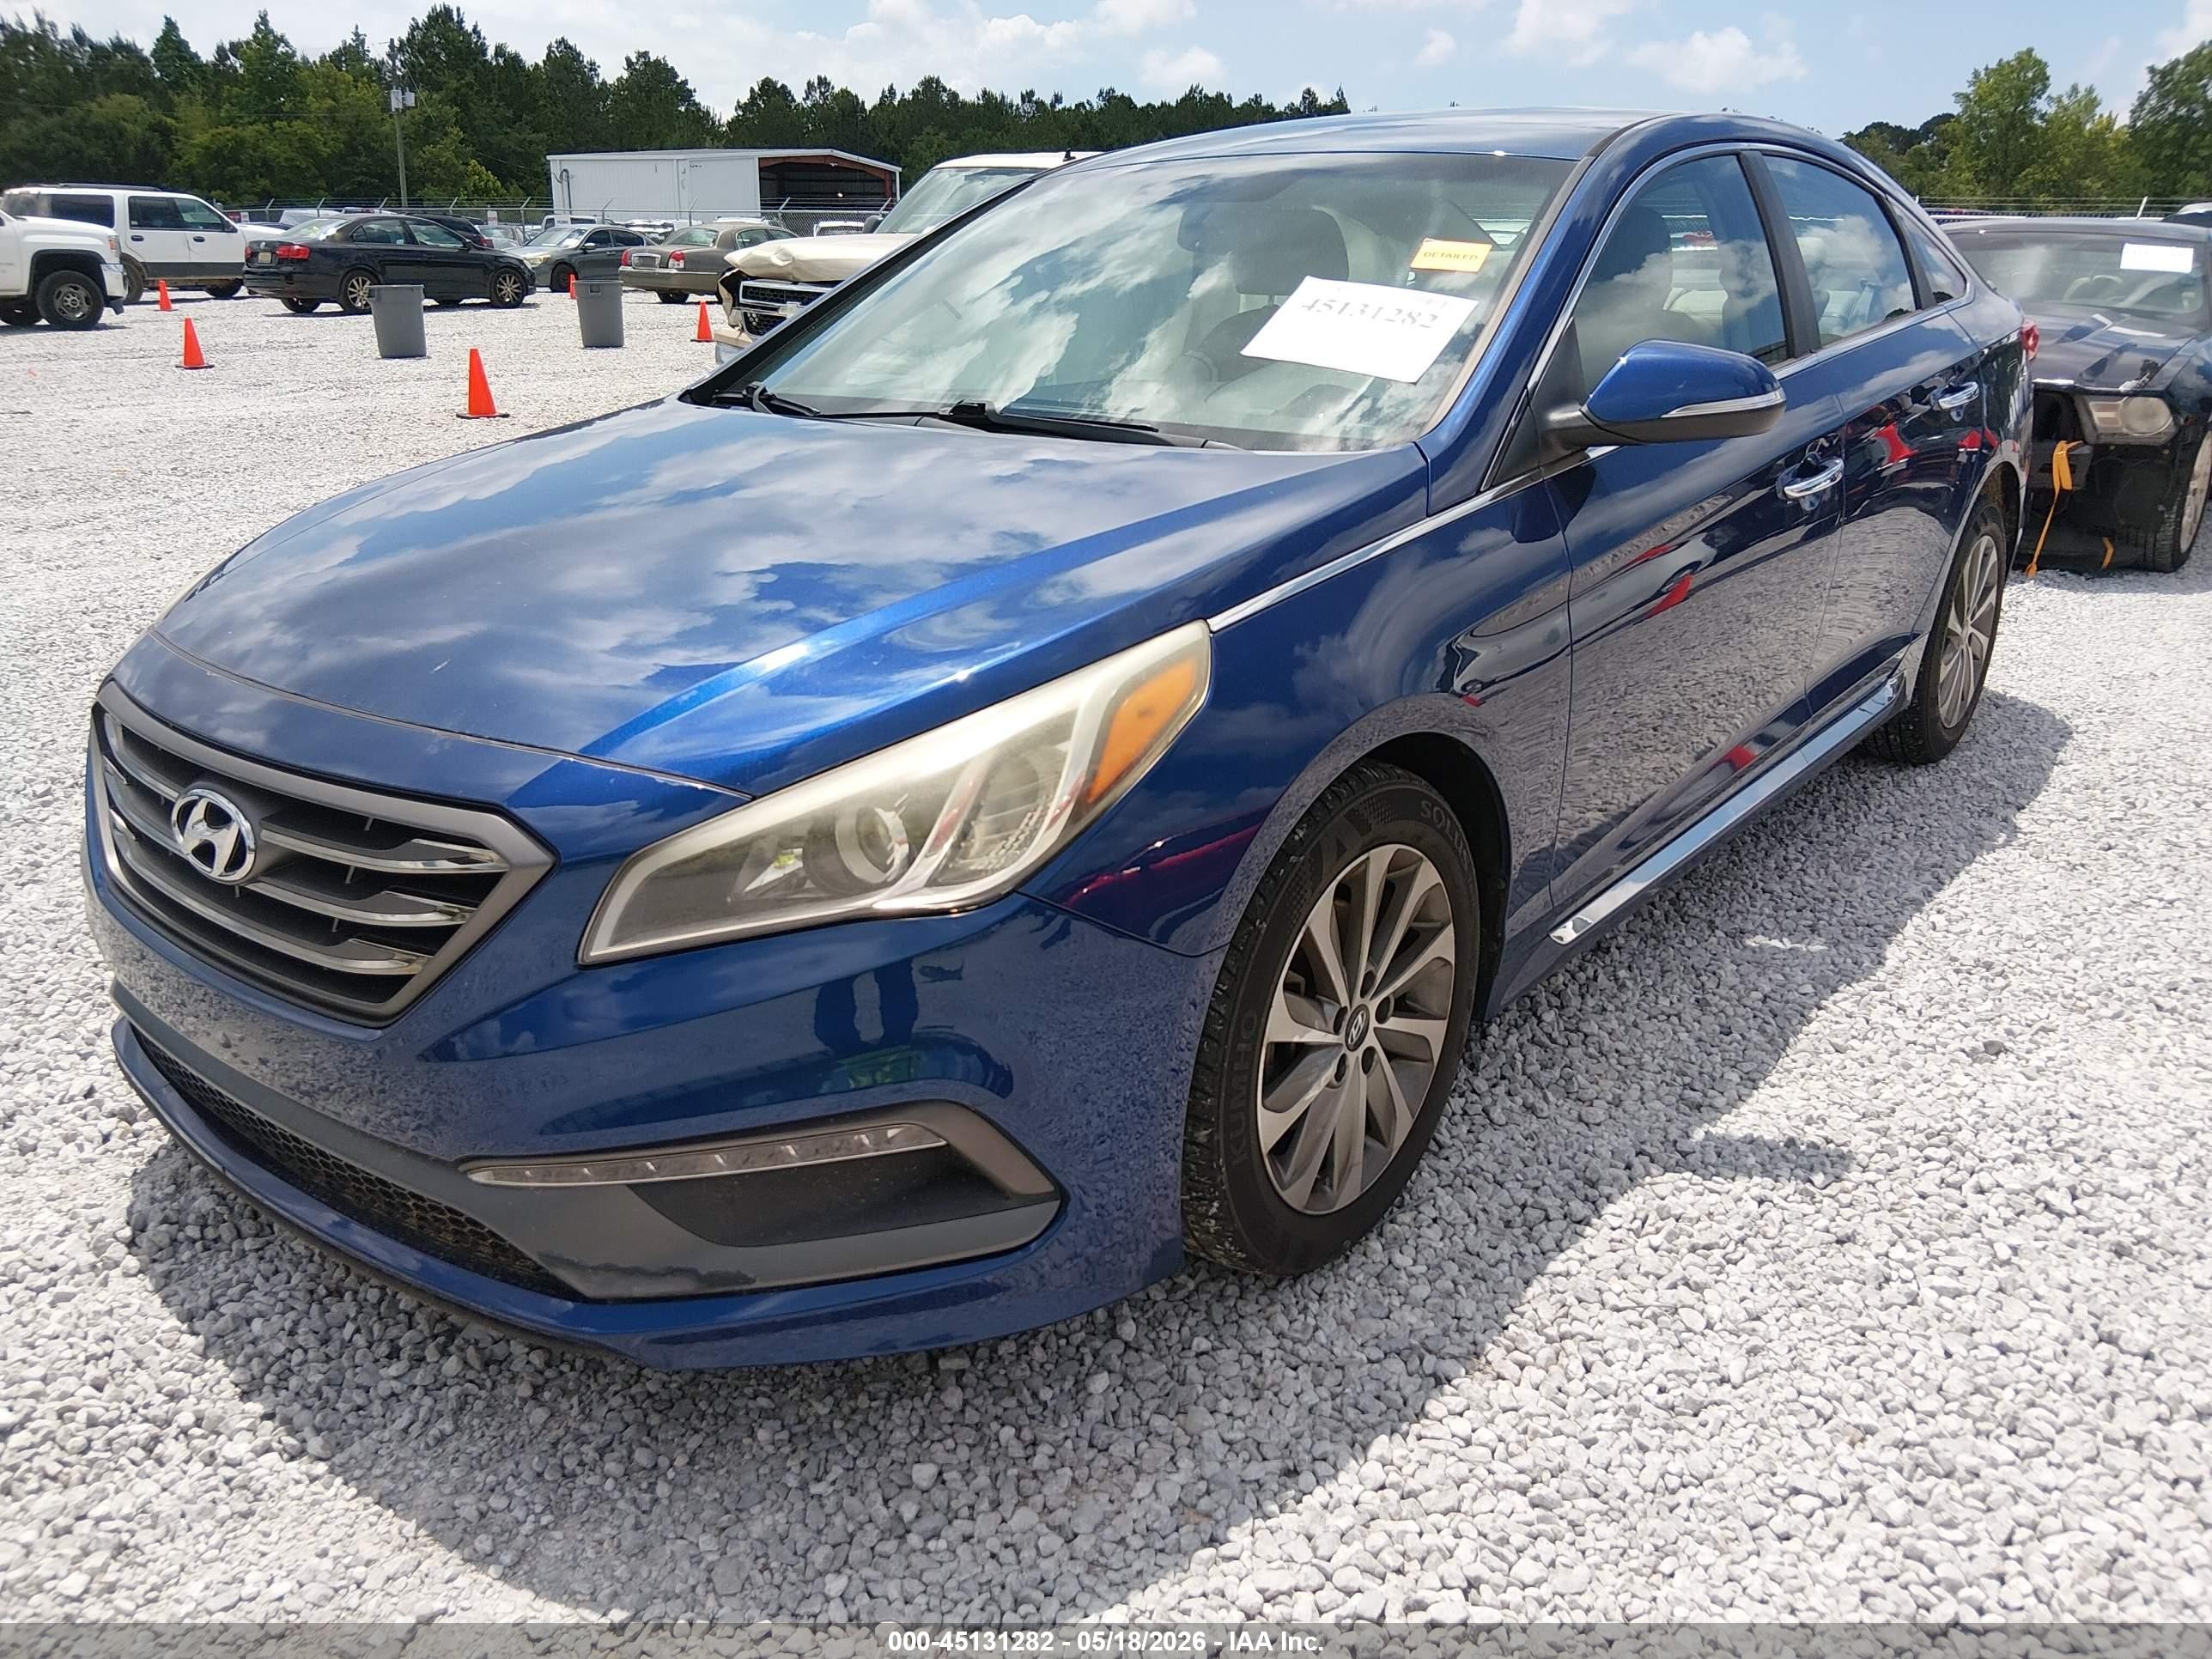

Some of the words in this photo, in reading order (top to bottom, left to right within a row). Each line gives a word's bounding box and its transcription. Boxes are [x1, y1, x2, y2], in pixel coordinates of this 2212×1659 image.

[1423, 251, 1479, 261] DETAILED
[1301, 298, 1439, 329] 45131282
[1420, 799, 1468, 872] SOLUS
[1229, 1009, 1258, 1166] KUMHO
